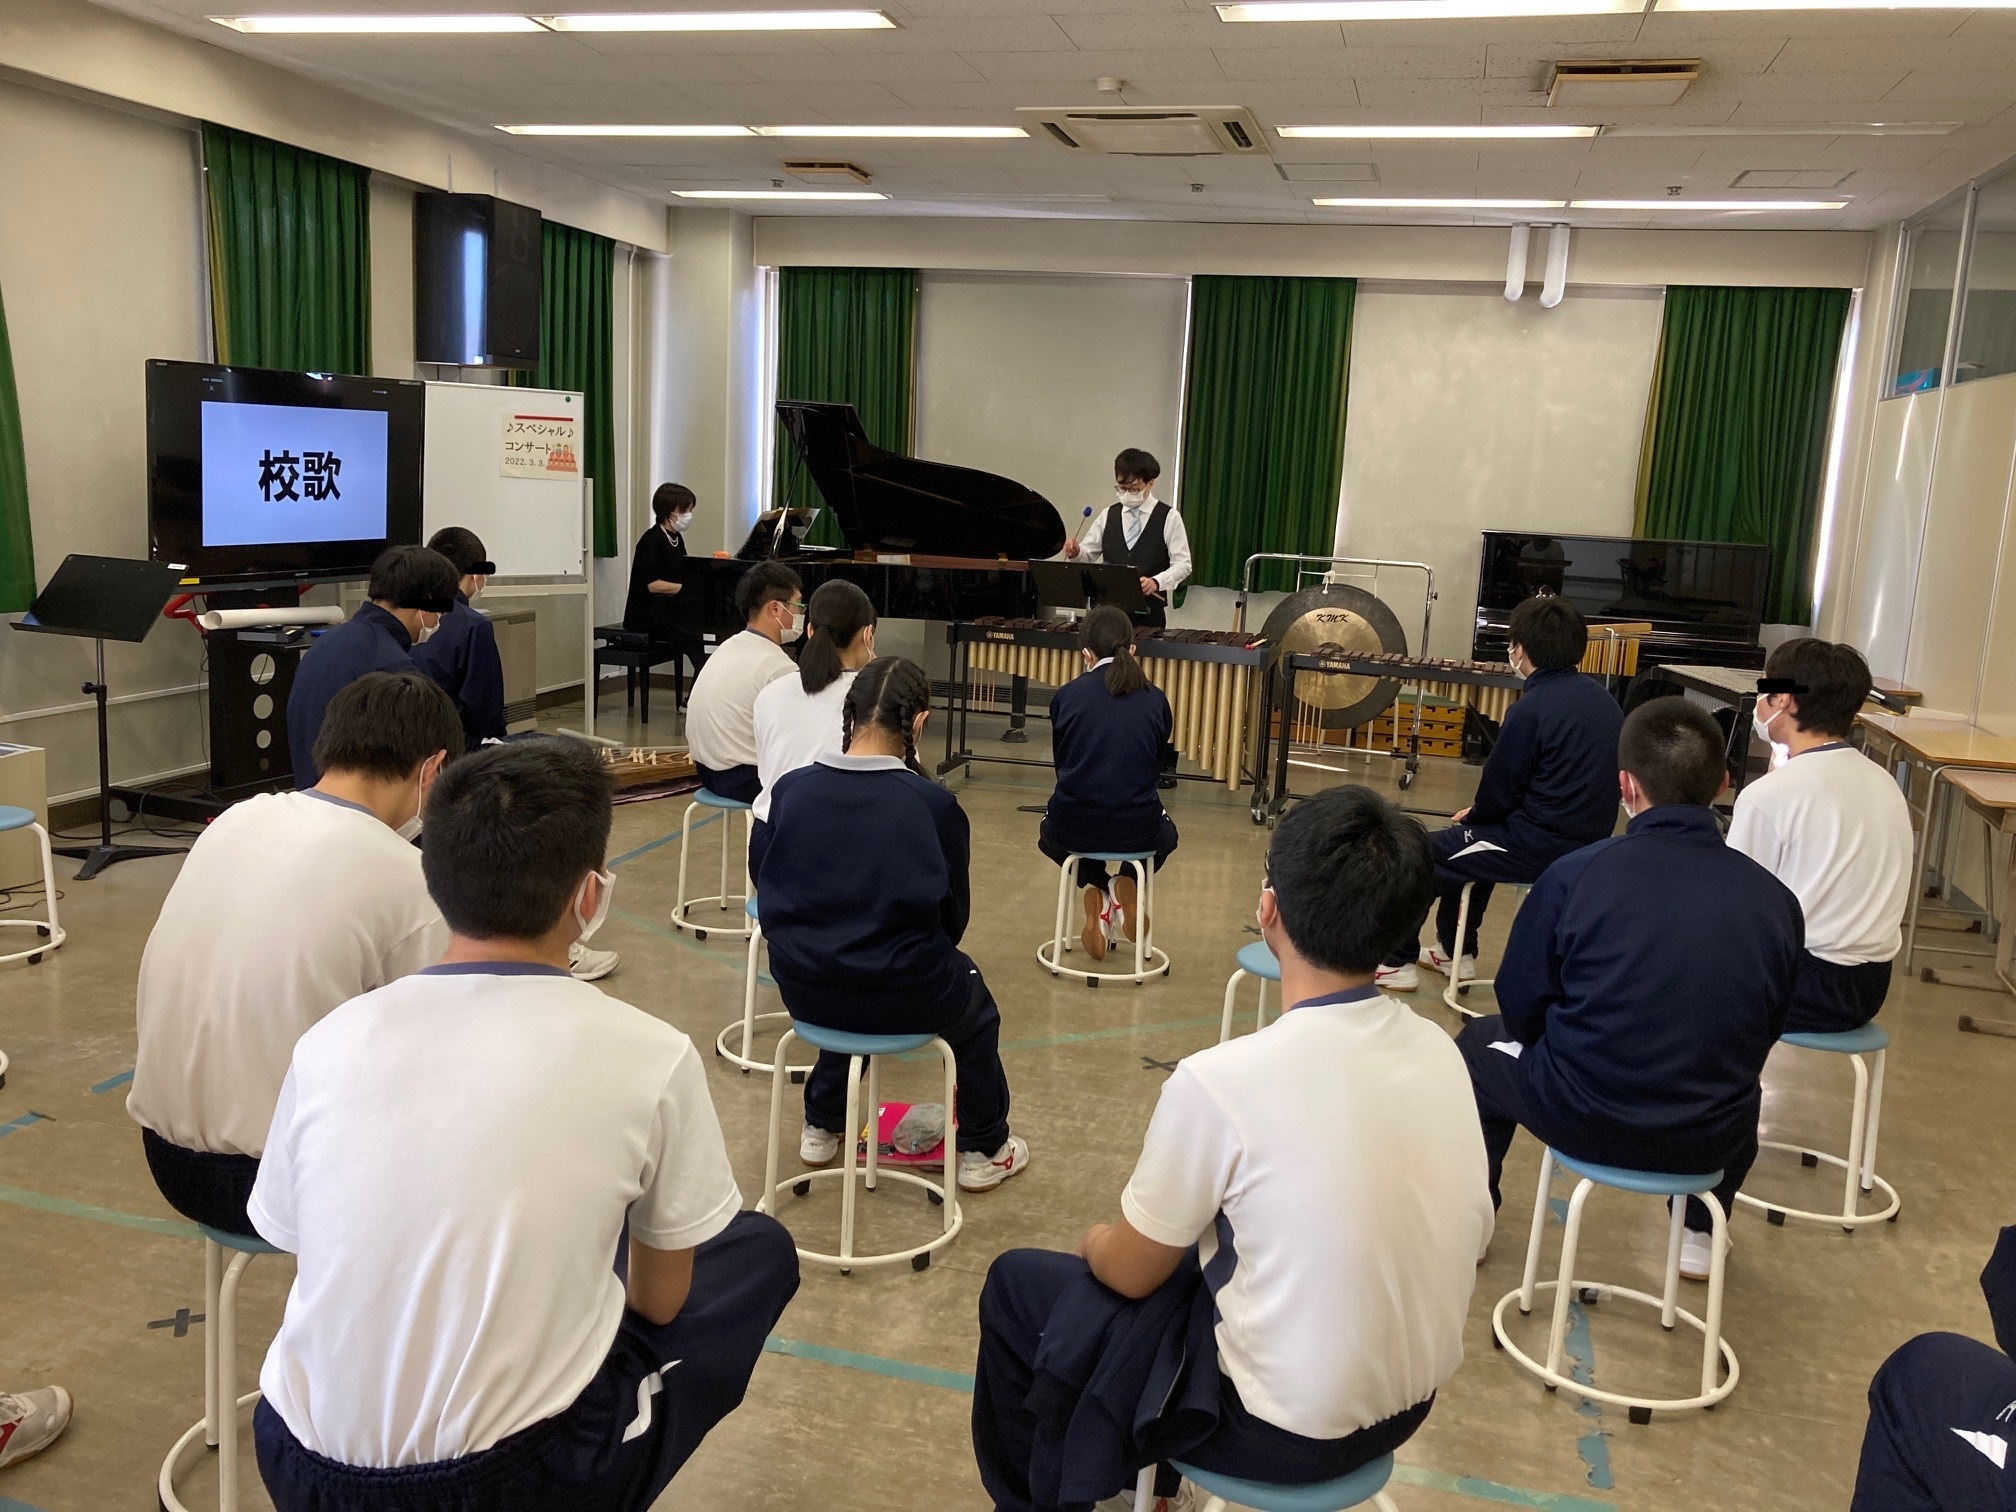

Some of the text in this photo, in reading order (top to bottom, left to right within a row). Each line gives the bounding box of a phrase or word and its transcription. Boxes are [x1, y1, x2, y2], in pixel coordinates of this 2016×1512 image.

[515, 423, 566, 436] スペシャル
[505, 442, 551, 454] コンサート
[258, 449, 342, 502] 校歌
[1316, 614, 1349, 623] KMK
[993, 632, 1015, 640] YAMAHA
[1326, 661, 1351, 670] YAMAHA
